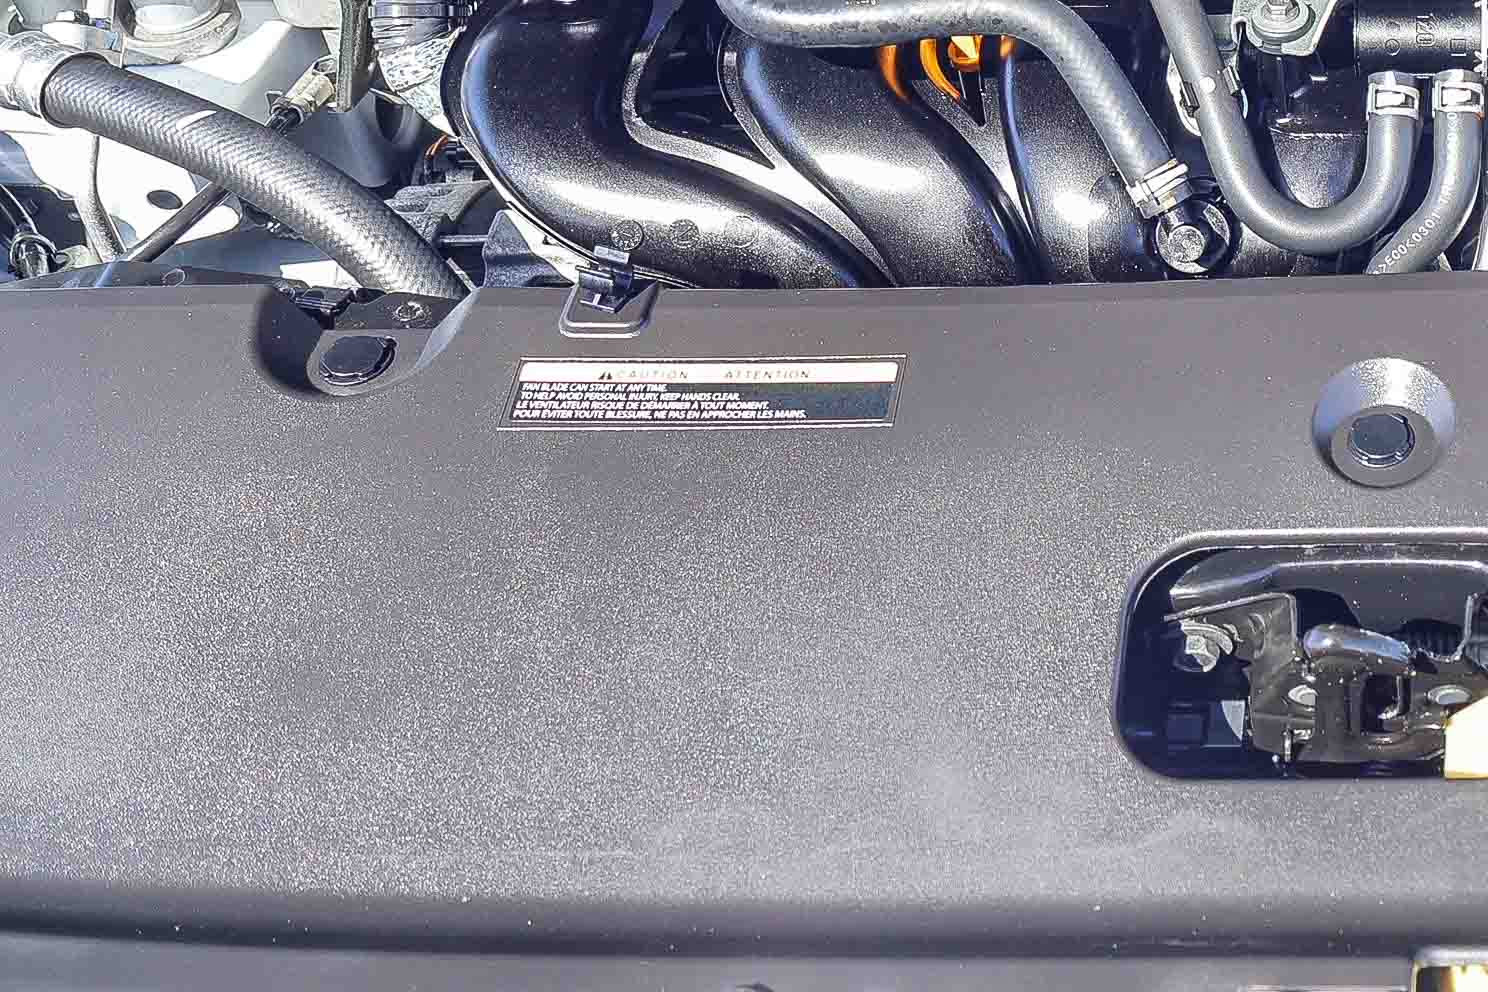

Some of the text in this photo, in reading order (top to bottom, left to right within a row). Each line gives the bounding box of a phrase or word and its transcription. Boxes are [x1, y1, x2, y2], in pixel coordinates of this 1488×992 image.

[616, 369, 688, 379] CAUTION
[725, 369, 811, 379] ATTENTION
[522, 383, 668, 392] FAN BLADE CAN START AT ANY TIME.
[520, 392, 532, 401] TO
[533, 392, 556, 401] HELP
[556, 392, 583, 401] AVOID
[583, 392, 627, 401] PERSONAL
[660, 392, 681, 401] KEEP
[681, 392, 711, 401] HANDS
[711, 392, 740, 401] CLEAR.
[516, 401, 528, 410] LE
[529, 401, 590, 410] VENTILATEUR
[591, 401, 625, 410] RISQUE
[626, 401, 642, 410] DE
[643, 399, 693, 410] DÉMARRER
[700, 401, 726, 410] TOUT
[726, 401, 770, 410] MOMENT.
[512, 410, 541, 419] POUR
[542, 408, 573, 419] ÉVITER
[574, 410, 604, 419] TOUTE
[654, 410, 668, 419] NE
[668, 410, 686, 419] PAS
[686, 410, 700, 419] EN
[700, 410, 758, 419] APPROCHER
[757, 410, 773, 419] LES
[774, 410, 808, 419] MAINS.
